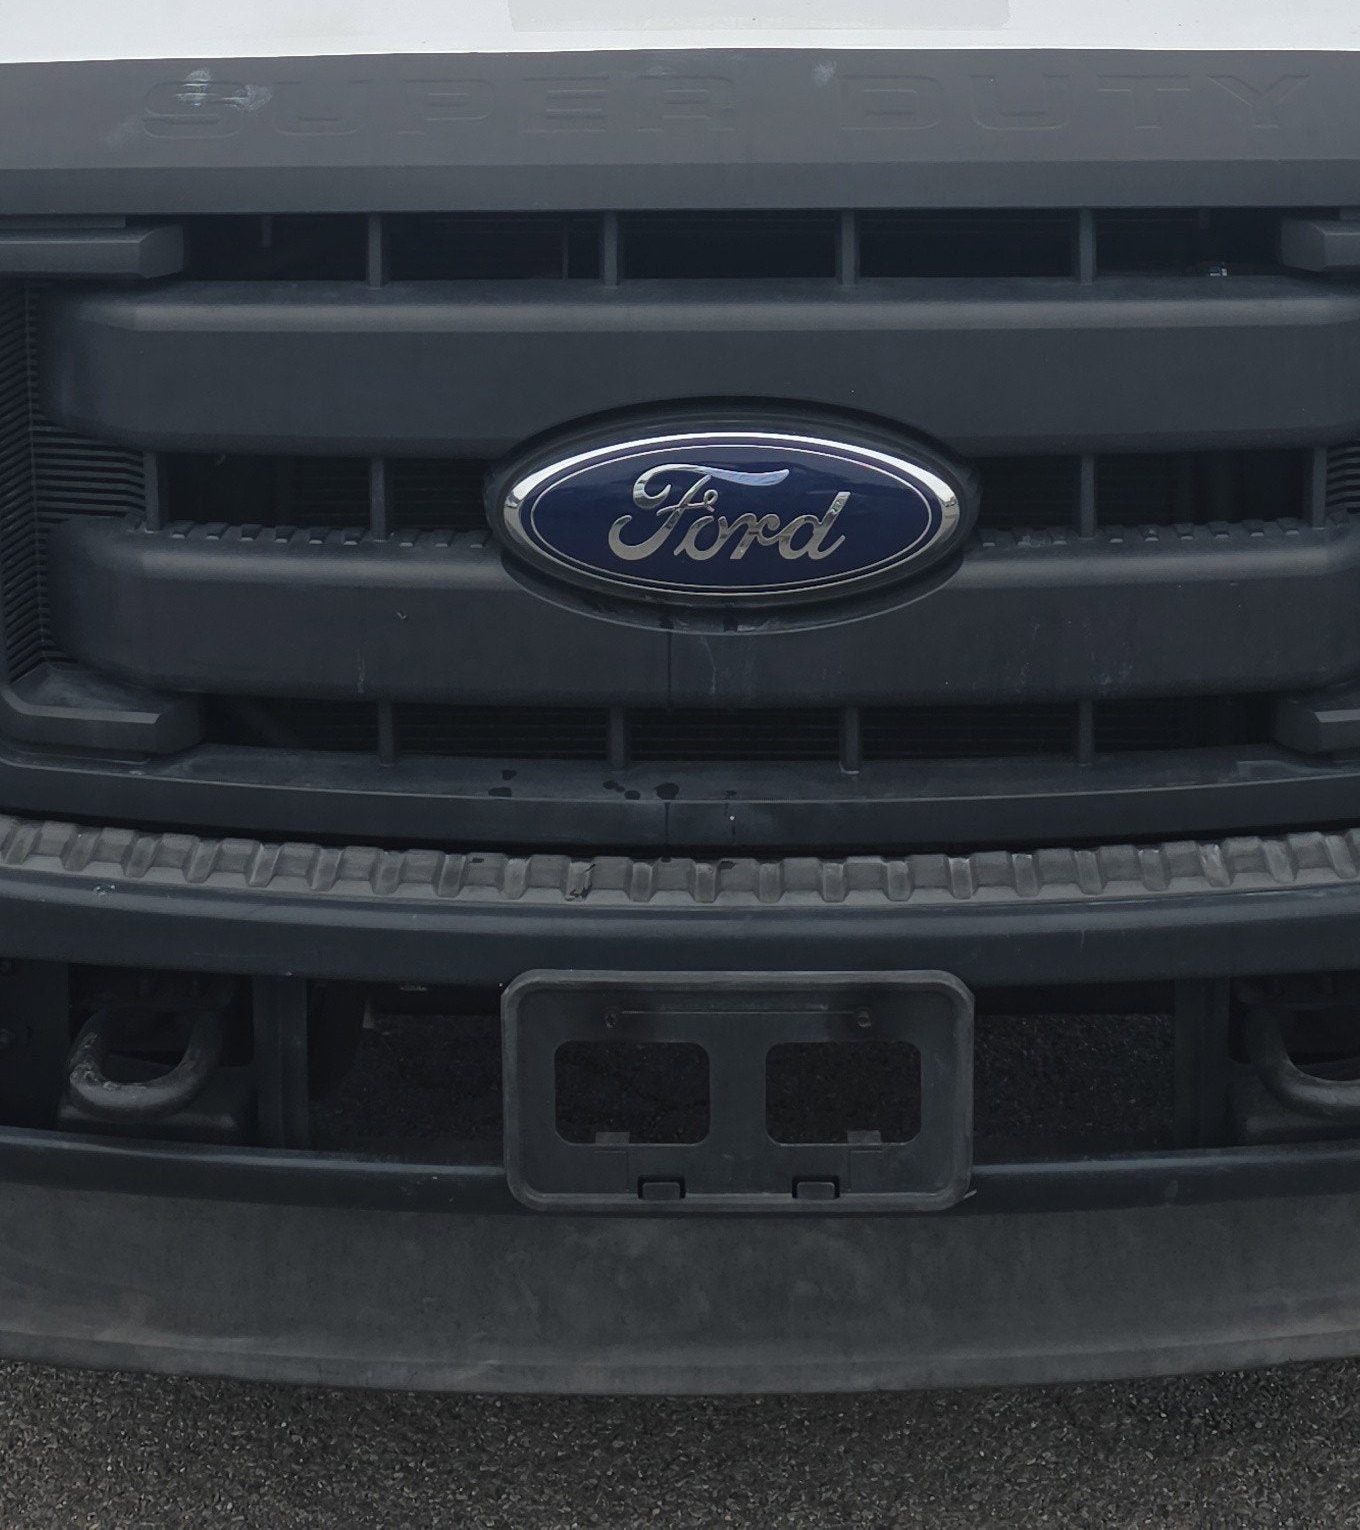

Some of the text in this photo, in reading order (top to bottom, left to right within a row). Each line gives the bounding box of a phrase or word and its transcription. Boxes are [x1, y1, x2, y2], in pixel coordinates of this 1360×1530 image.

[142, 73, 1313, 141] SUPER DUTY
[607, 463, 852, 562] Ford
